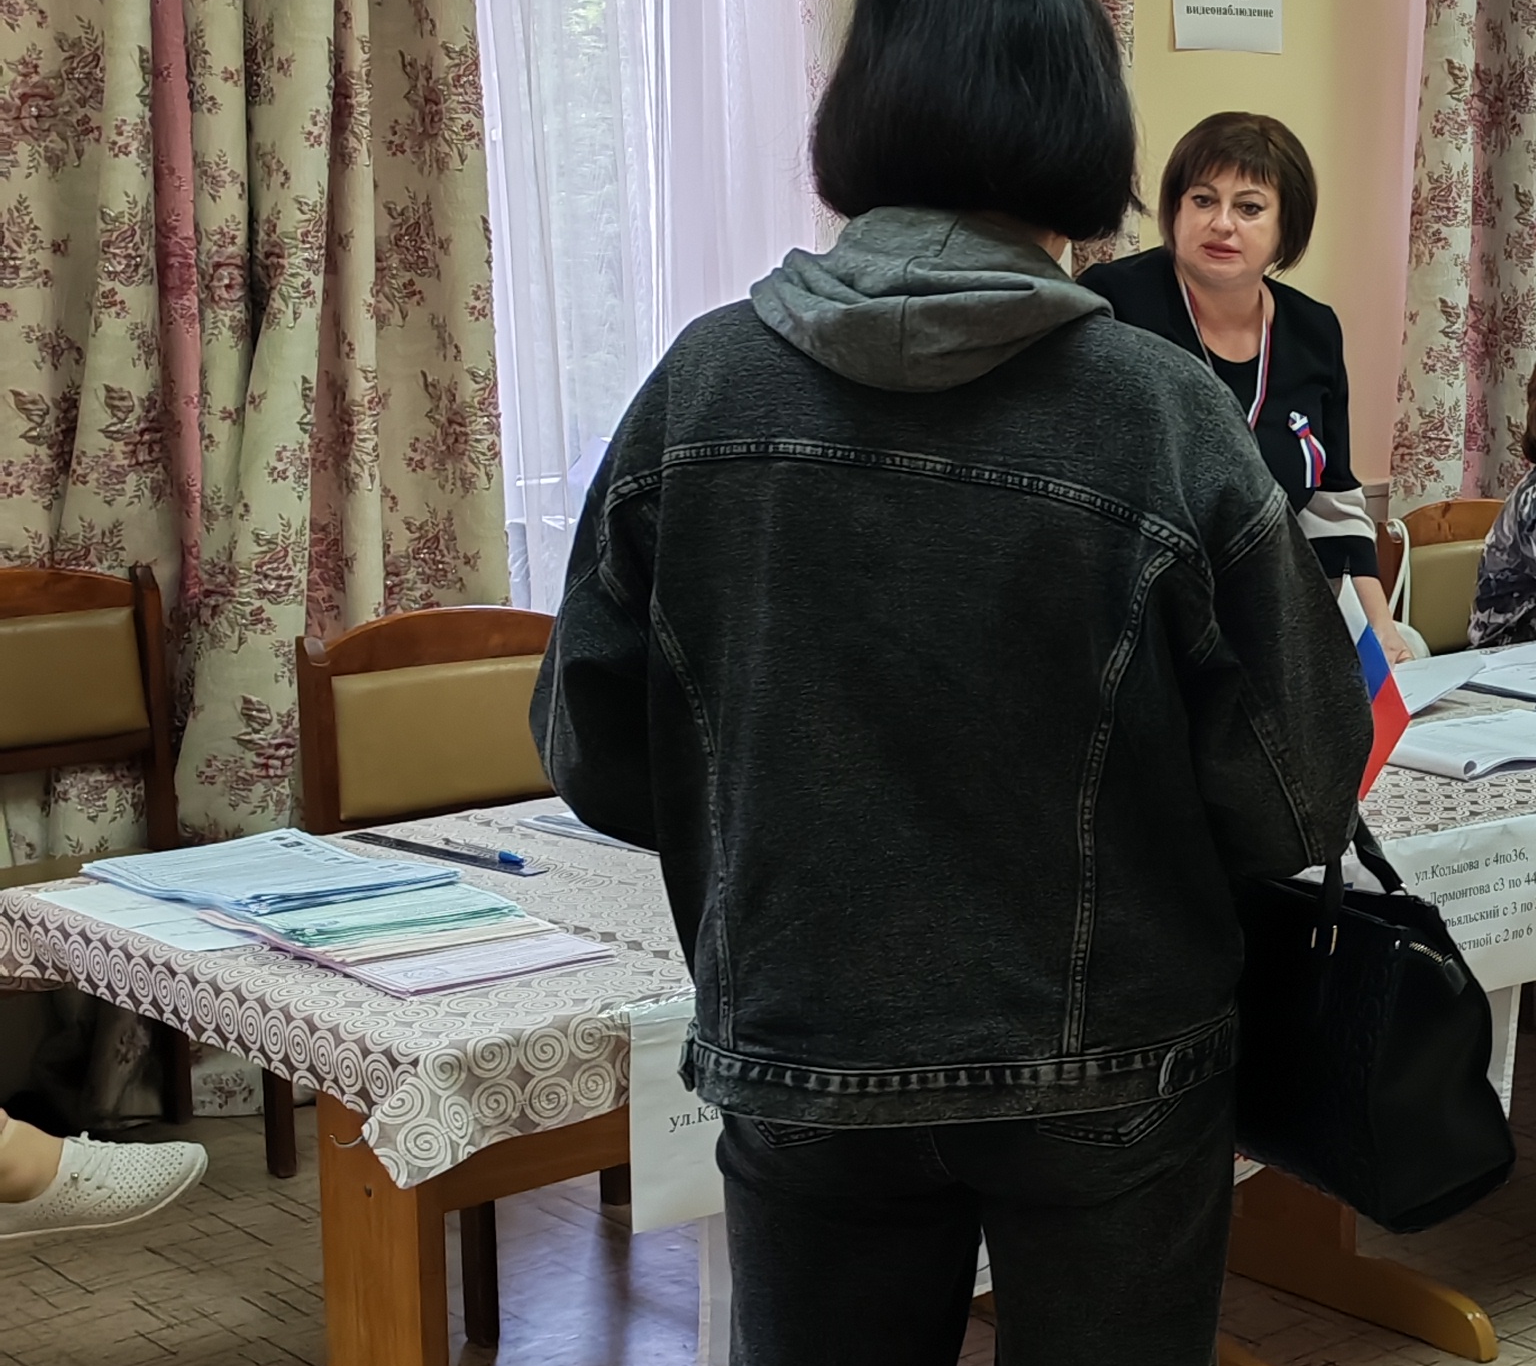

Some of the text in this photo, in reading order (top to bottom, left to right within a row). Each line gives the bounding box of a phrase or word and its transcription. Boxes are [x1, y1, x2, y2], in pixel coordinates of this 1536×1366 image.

[1186, 5, 1274, 18] видеонаблюдение
[1415, 860, 1480, 886] ул.Кольцова
[1421, 882, 1491, 907] Лермонтова
[1508, 878, 1522, 889] по
[1444, 905, 1500, 928] рьяльский
[1502, 906, 1509, 916] с
[1511, 901, 1518, 915] 3
[1520, 901, 1533, 913] по
[1495, 934, 1501, 944] с
[1503, 928, 1510, 942] 2
[1511, 928, 1525, 940] по
[1526, 923, 1533, 936] 6
[669, 1105, 719, 1133] ул.Ка
